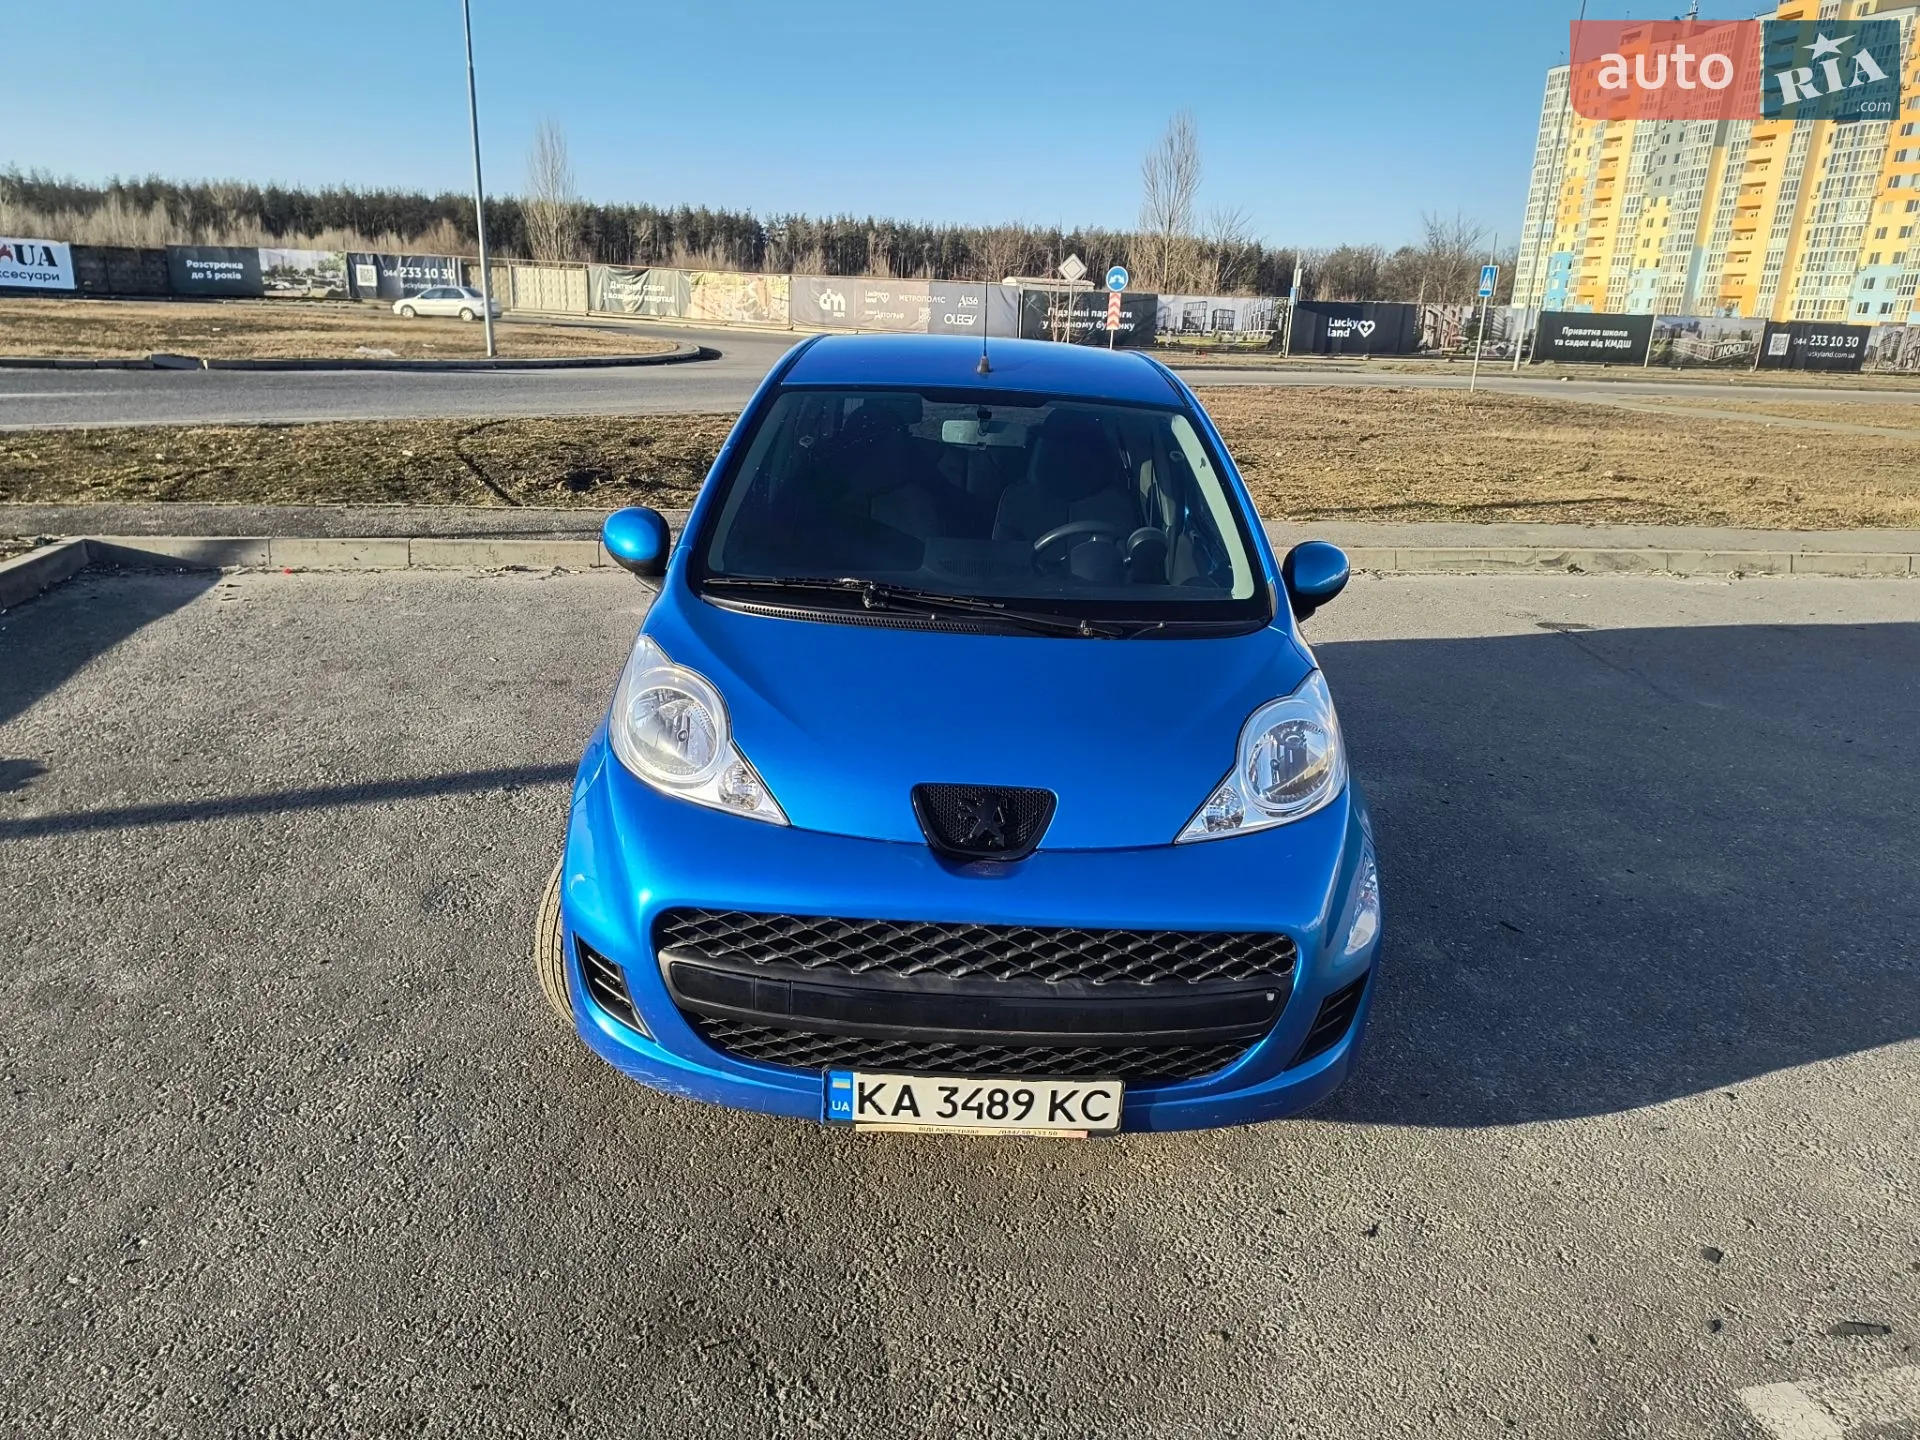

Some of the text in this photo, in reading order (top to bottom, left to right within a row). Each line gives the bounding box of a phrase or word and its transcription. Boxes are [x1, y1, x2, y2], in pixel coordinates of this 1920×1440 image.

[186, 259, 244, 270] Розстрочка
[191, 270, 242, 281] до 5 років
[400, 266, 421, 278] 233
[424, 268, 438, 279] 10
[440, 268, 455, 280] 30
[1096, 320, 1135, 331] бунку
[1328, 317, 1359, 330] Lucky
[1327, 327, 1351, 338] land
[1562, 326, 1629, 337] Приватна школа
[1564, 339, 1589, 347] садок
[1590, 338, 1604, 348] від
[1604, 339, 1632, 349] КМДШ
[1809, 334, 1828, 346] 233
[1829, 336, 1843, 347] 10
[1844, 336, 1859, 348] 30
[832, 1100, 850, 1112] UA
[858, 1082, 1111, 1122] KA 3489 KC
